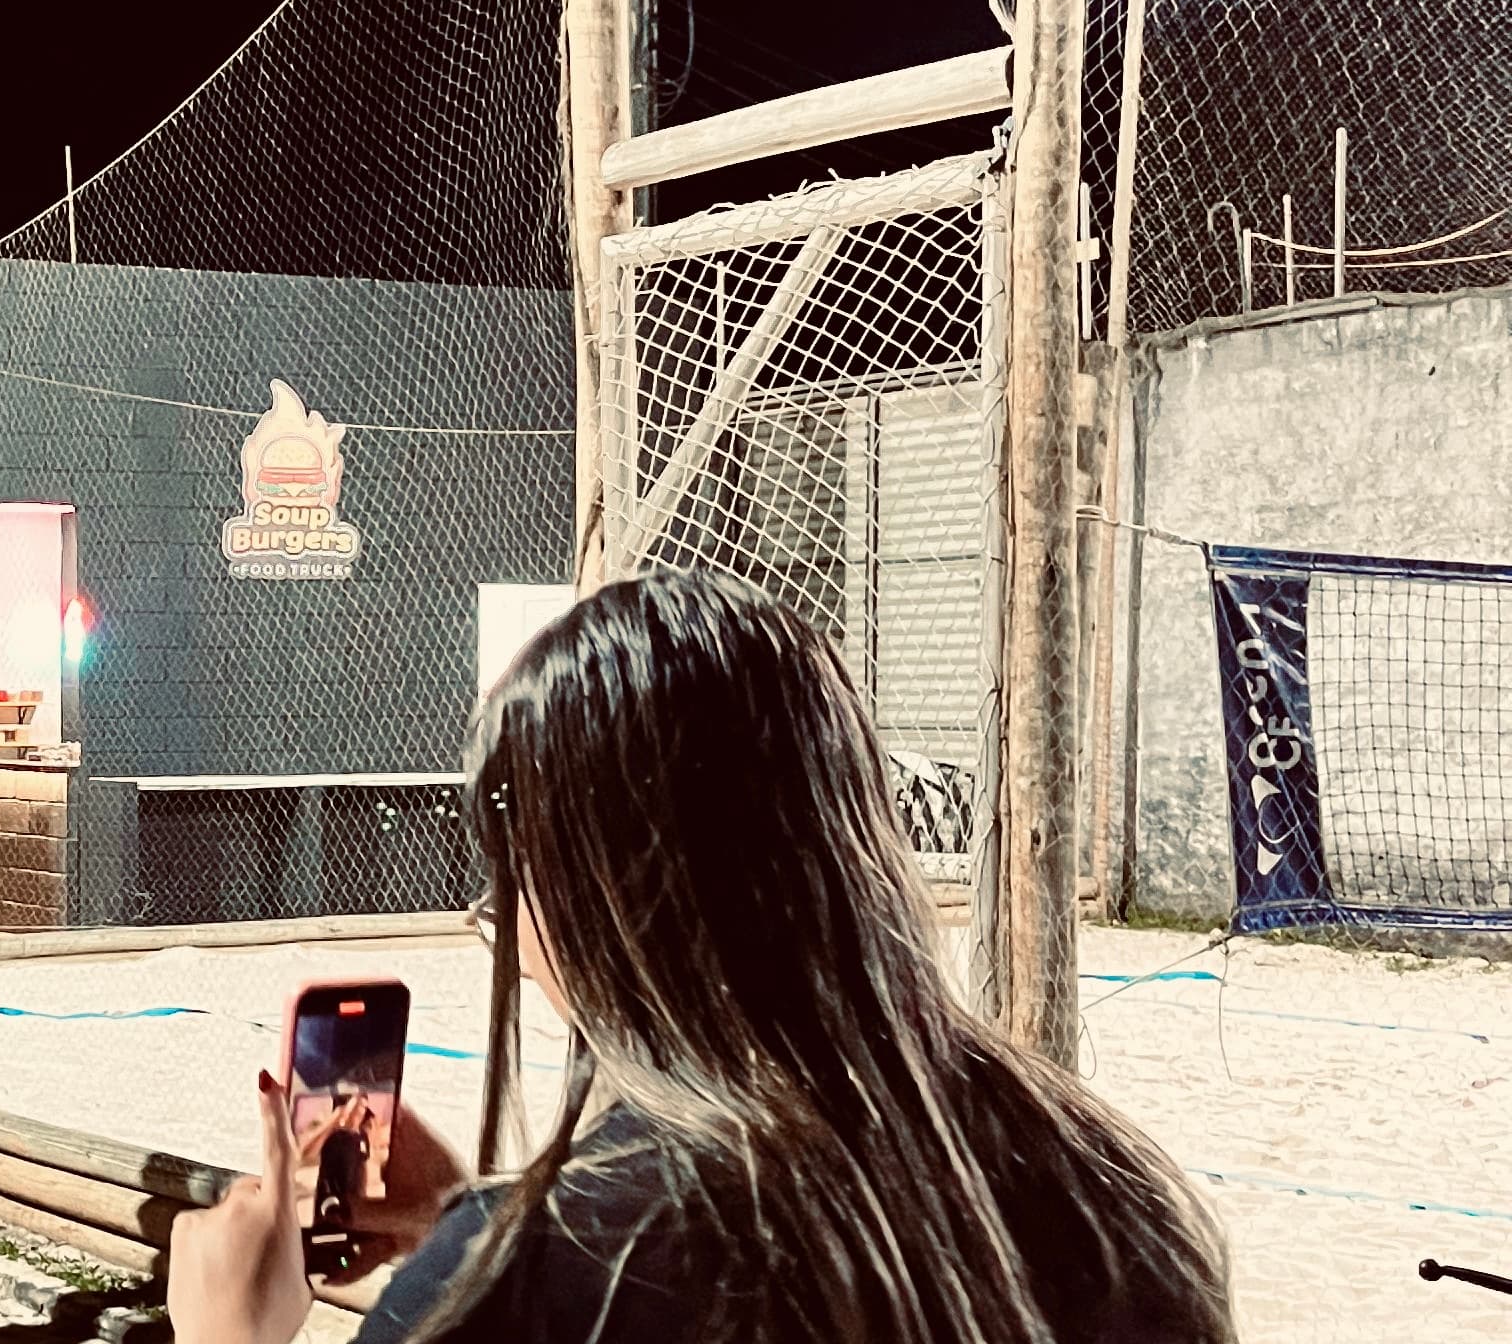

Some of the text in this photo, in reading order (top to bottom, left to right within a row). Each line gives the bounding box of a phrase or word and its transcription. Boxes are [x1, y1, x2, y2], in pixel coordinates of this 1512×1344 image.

[254, 501, 330, 530] Soup
[232, 527, 353, 555] Burgers
[240, 563, 345, 577] FOOD TRUCK
